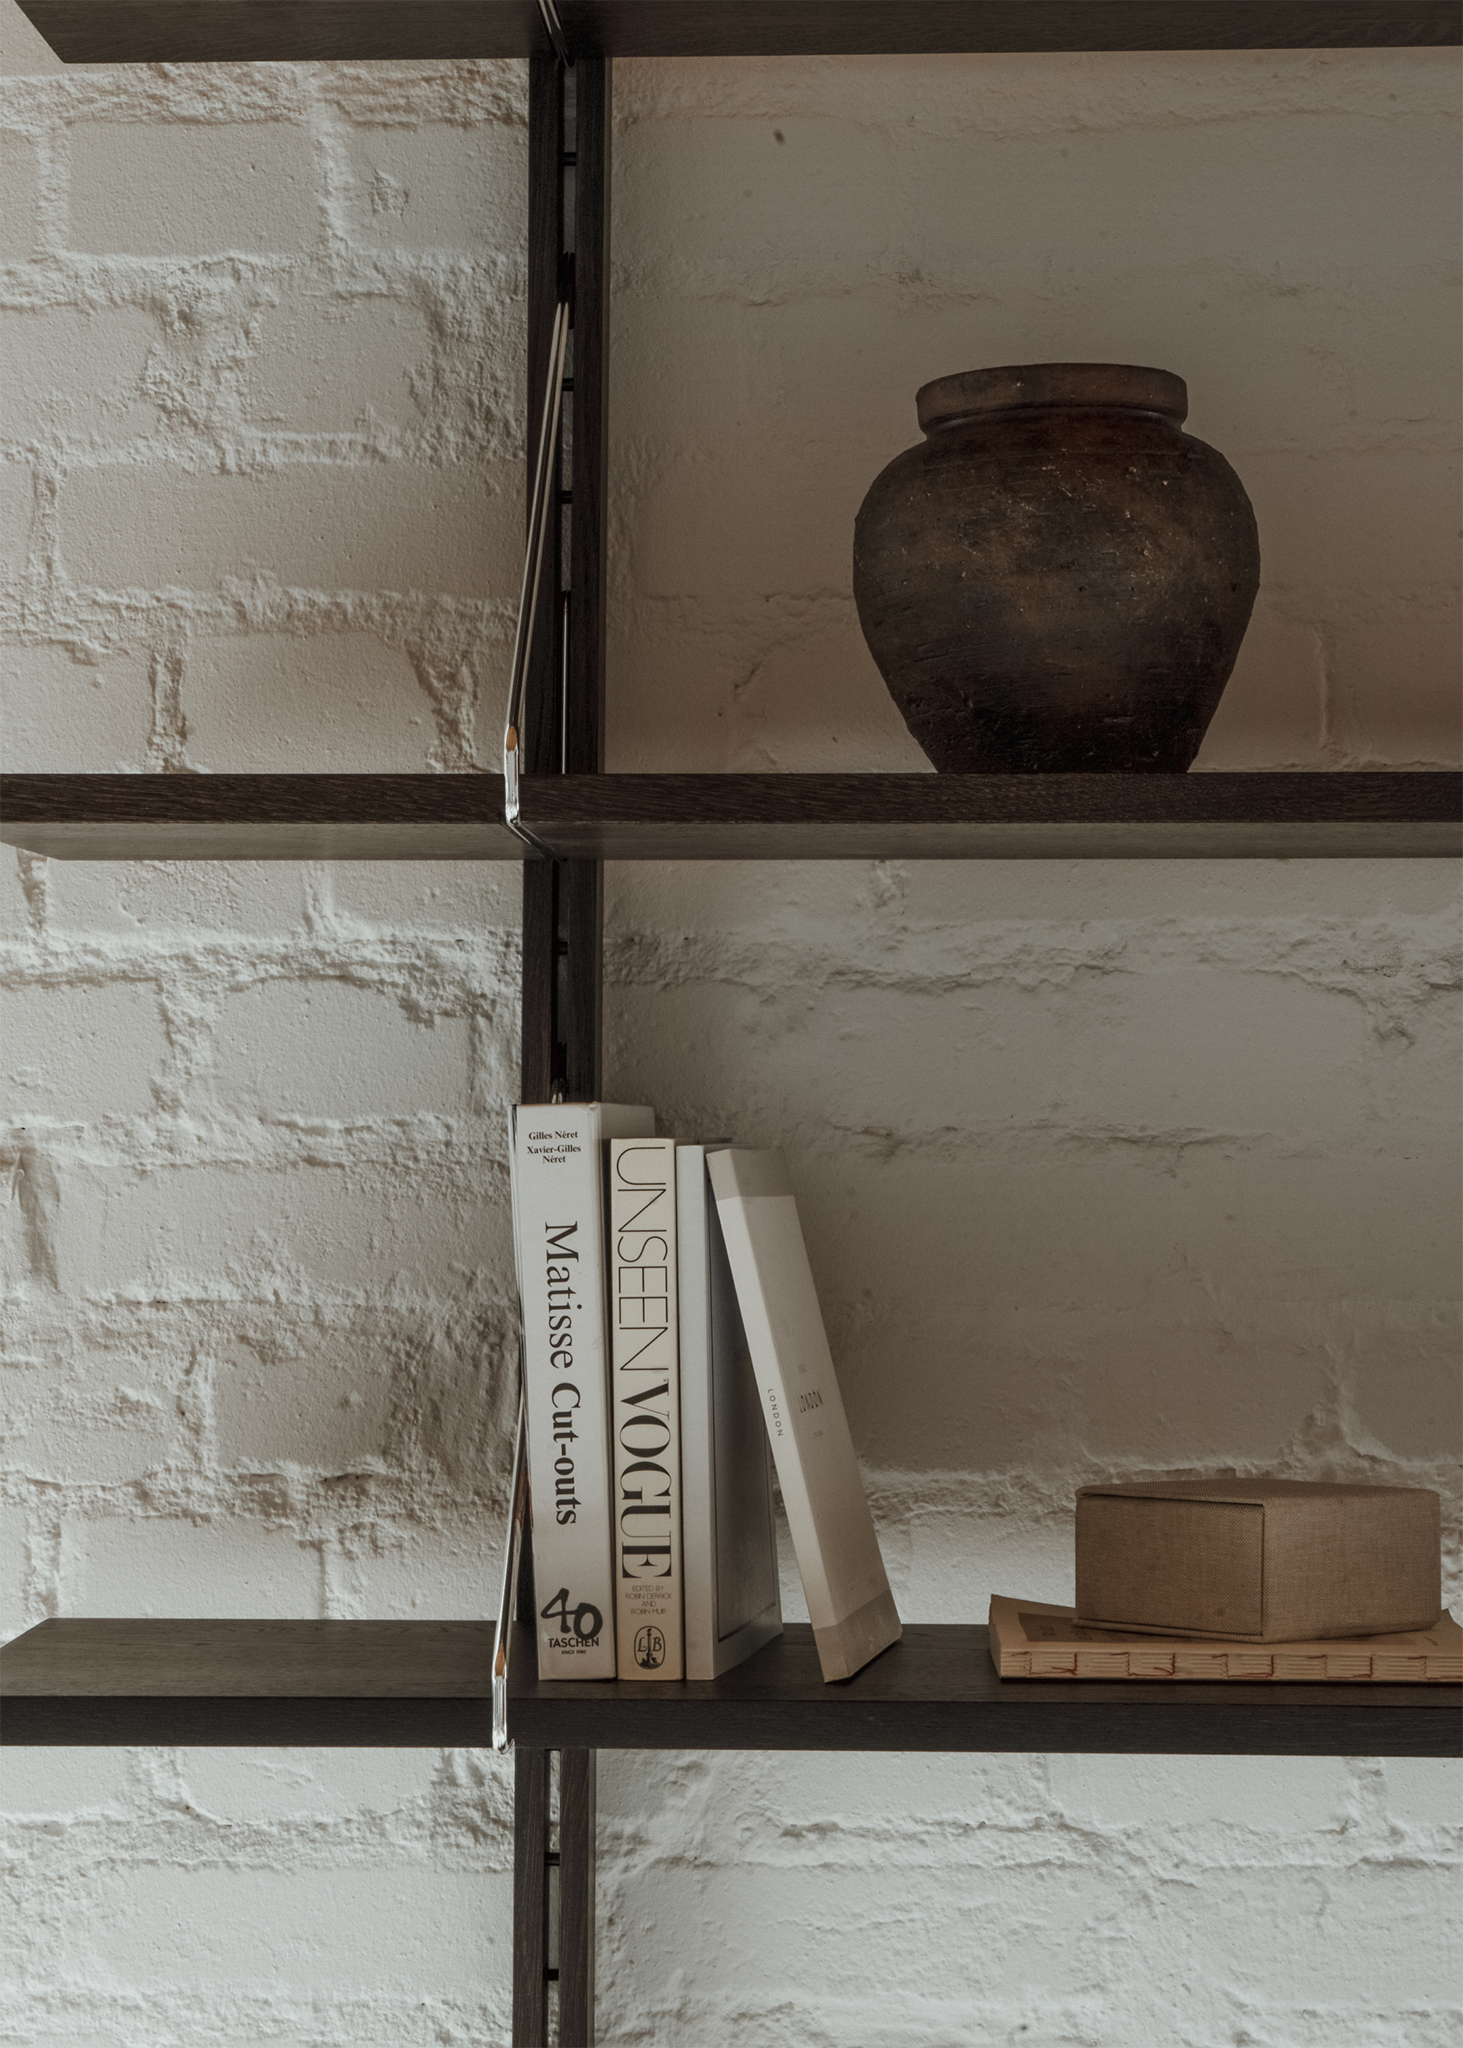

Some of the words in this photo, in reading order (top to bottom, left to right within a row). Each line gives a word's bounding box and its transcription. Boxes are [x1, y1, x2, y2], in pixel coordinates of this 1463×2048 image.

[527, 1144, 582, 1155] Xavier-Gilles
[528, 1131, 553, 1141] Gilles
[554, 1130, 578, 1140] Néret
[542, 1155, 566, 1164] Néret
[616, 1146, 669, 1371] UNSEEN
[544, 1221, 583, 1369] Matisse
[767, 1388, 784, 1437] LONDON
[550, 1382, 582, 1526] Cut-outs
[619, 1381, 672, 1579] VOGUE
[625, 1592, 646, 1600] ROBIN
[646, 1592, 672, 1600] DERRICK
[631, 1584, 654, 1592] EDITED
[540, 1587, 603, 1640] 40
[548, 1637, 600, 1648] TASCHEN
